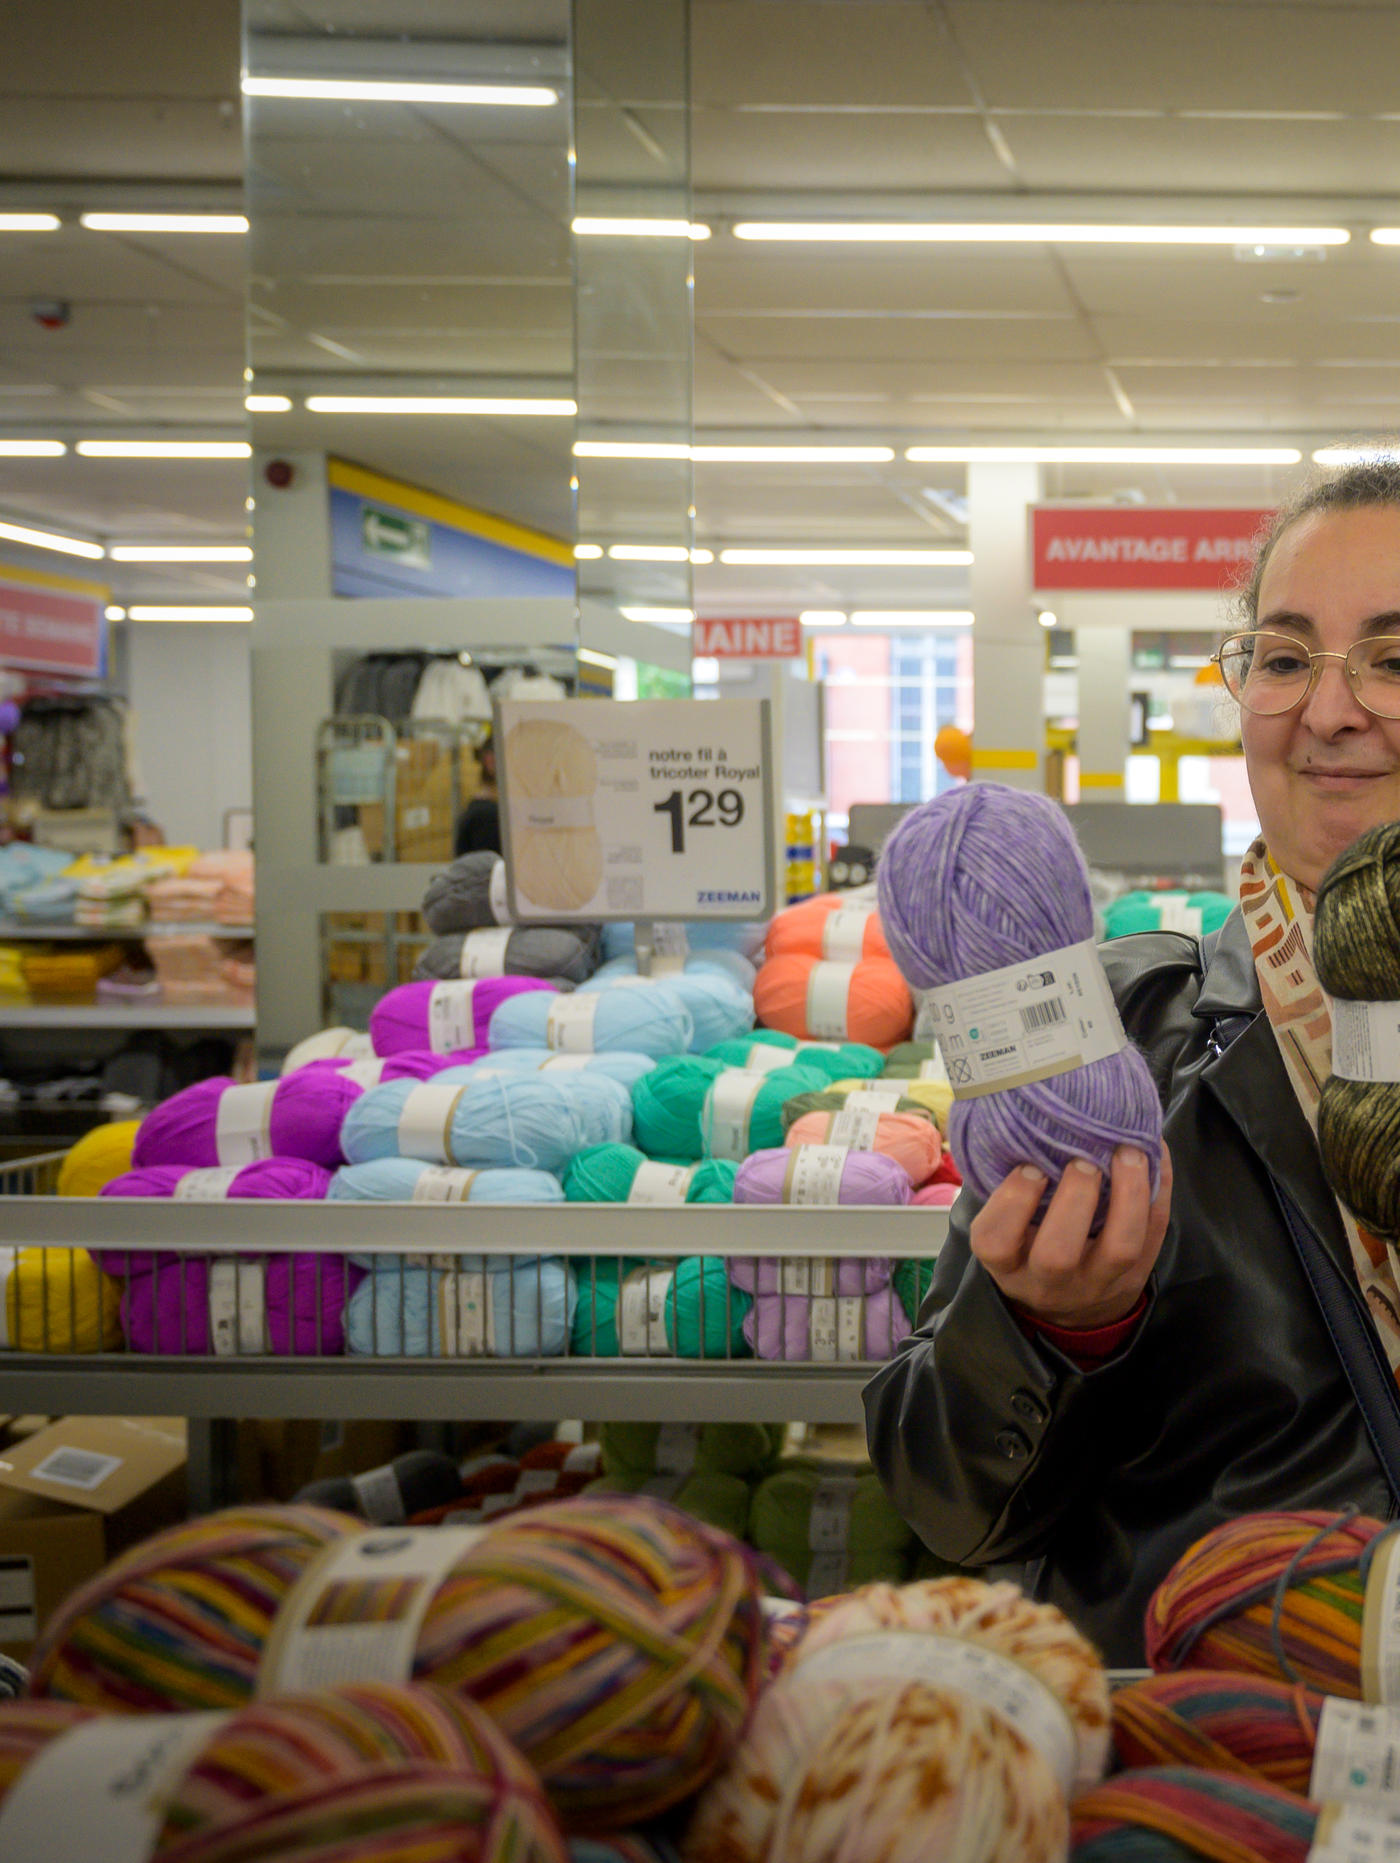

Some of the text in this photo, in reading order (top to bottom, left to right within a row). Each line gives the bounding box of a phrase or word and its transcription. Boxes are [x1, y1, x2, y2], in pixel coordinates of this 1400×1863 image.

[1047, 537, 1254, 562] AVANTAGE ARR
[649, 749, 692, 762] notre
[697, 748, 713, 762] fil
[718, 748, 728, 762] à
[650, 765, 760, 782] tricoter Royal
[697, 890, 760, 903] ZEEMAN
[980, 1044, 1017, 1062] ZEEMAN
